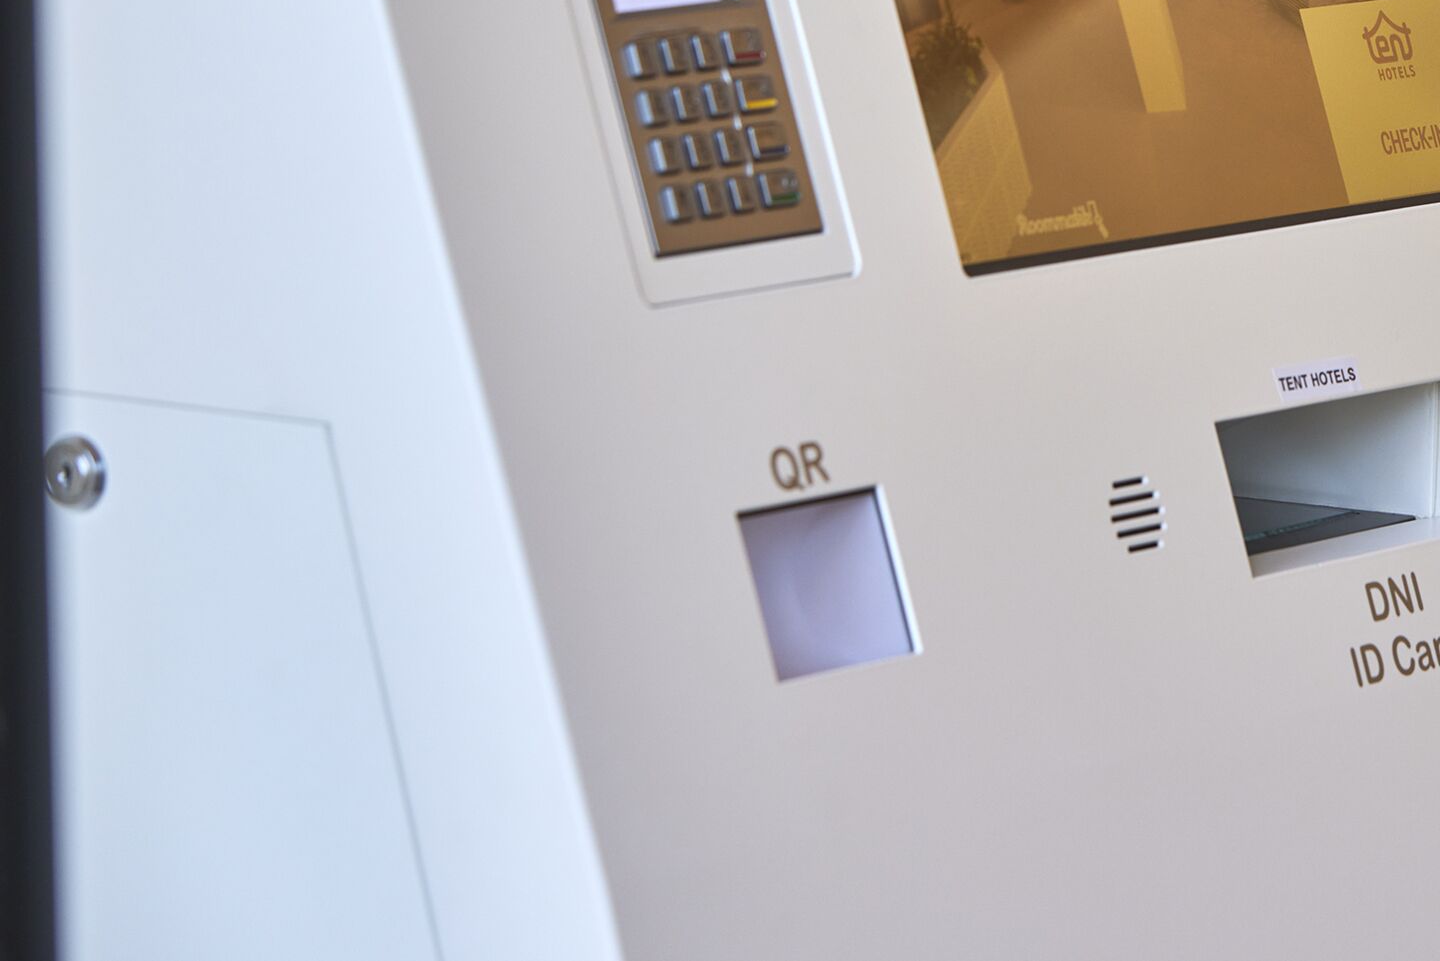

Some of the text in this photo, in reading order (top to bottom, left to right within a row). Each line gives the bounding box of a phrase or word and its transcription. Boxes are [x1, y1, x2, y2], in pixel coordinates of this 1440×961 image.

[1377, 64, 1416, 81] HOTELS
[1278, 367, 1357, 392] TENT HOTELS
[769, 441, 830, 492] QR
[1364, 571, 1424, 622] DNI
[1350, 643, 1385, 688] ID
